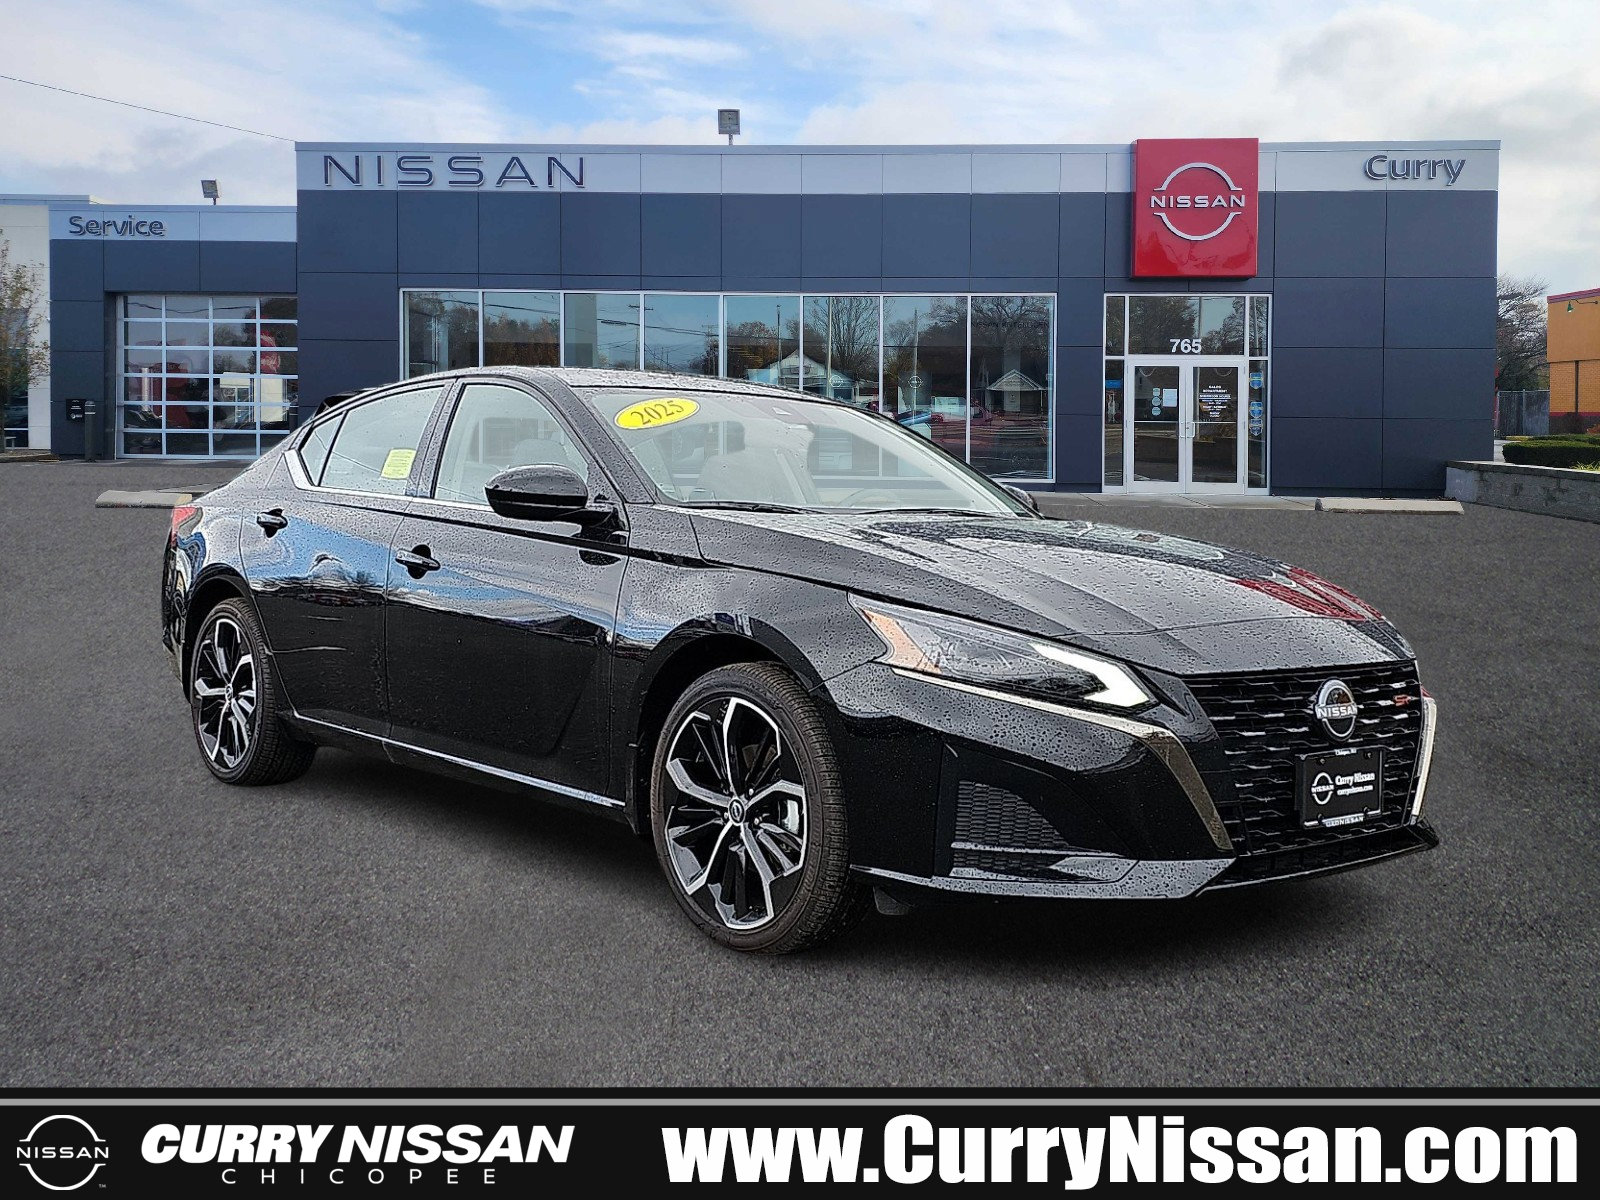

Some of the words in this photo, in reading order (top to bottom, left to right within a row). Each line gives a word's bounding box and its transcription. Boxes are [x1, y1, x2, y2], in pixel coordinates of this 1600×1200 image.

[324, 155, 585, 188] NISSAN
[1365, 154, 1466, 187] Curry
[1151, 194, 1245, 209] NISSAN
[69, 214, 164, 237] Service
[1170, 338, 1202, 354] 765
[631, 400, 684, 425] 2025
[1318, 704, 1357, 719] NISSAN
